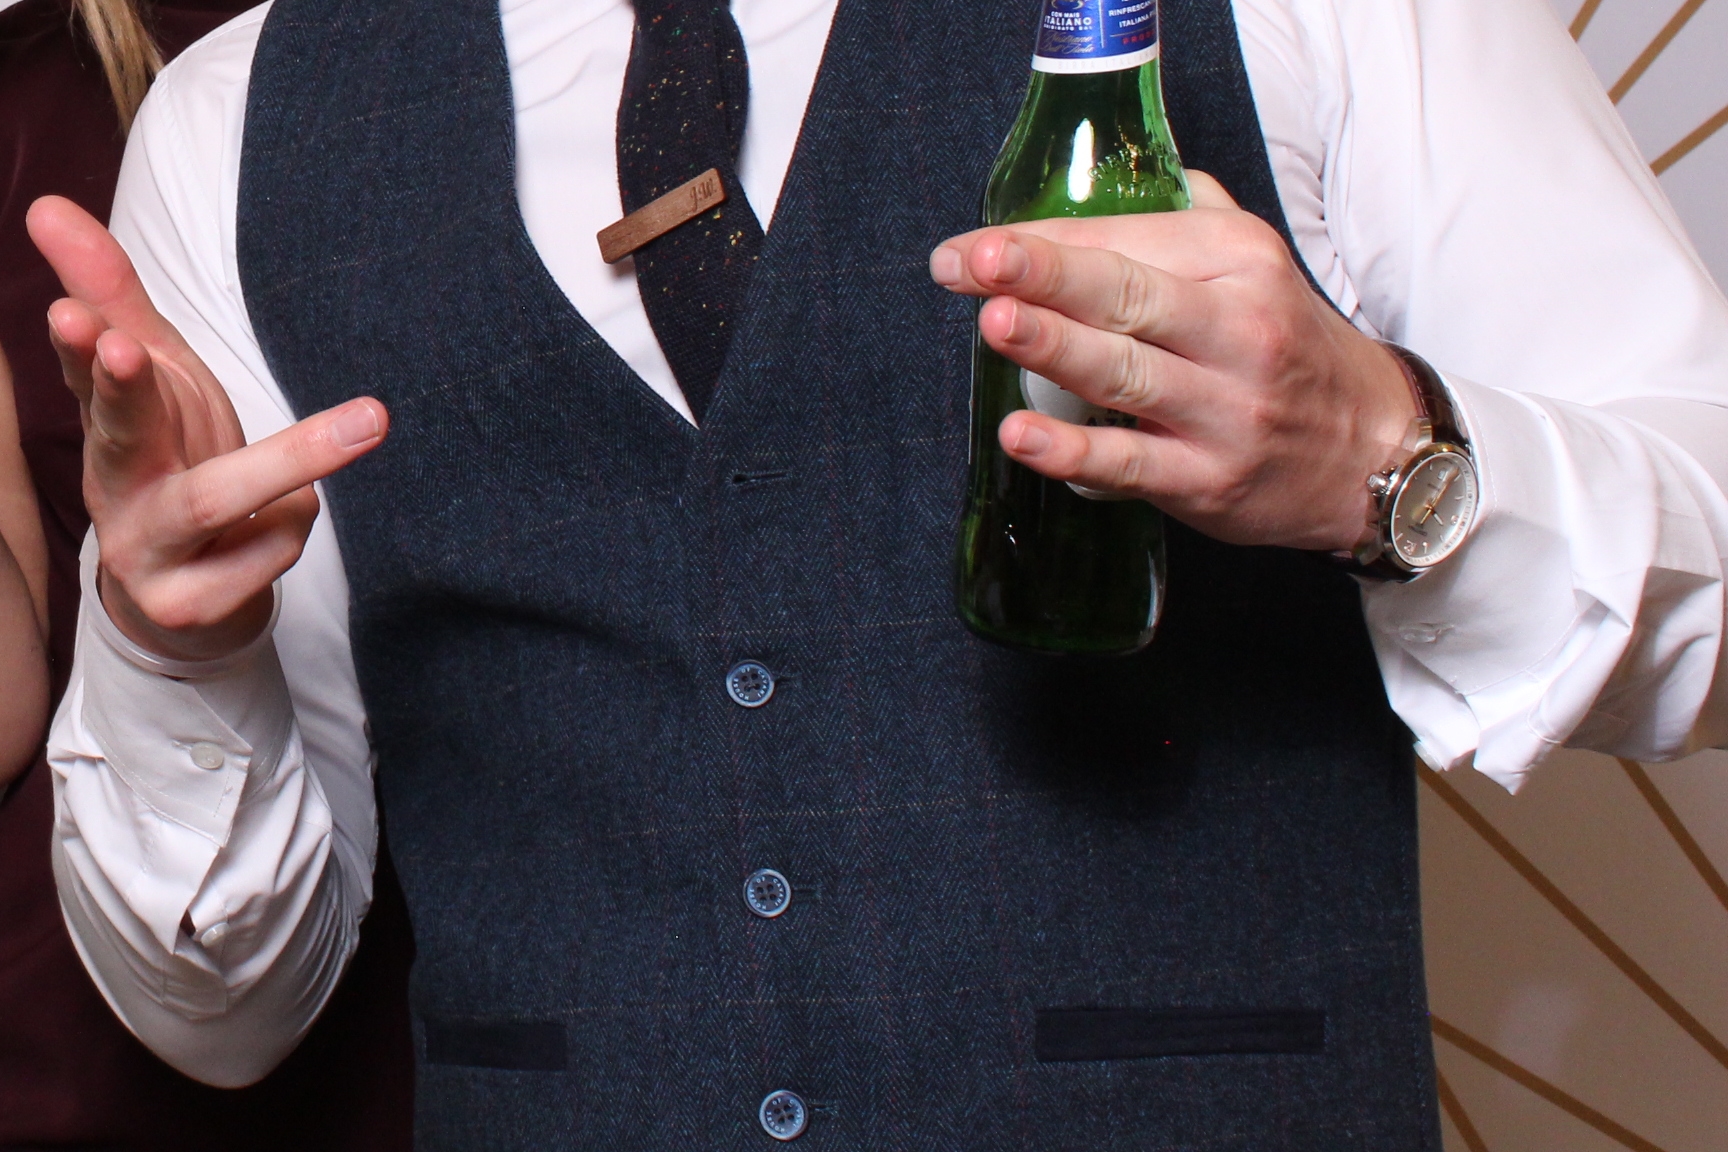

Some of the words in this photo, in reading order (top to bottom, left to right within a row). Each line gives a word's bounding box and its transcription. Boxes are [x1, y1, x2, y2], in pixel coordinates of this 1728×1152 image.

[1044, 15, 1092, 26] ITALIANO
[733, 677, 750, 700] HOUSE
[765, 1110, 785, 1132] HOUSE
